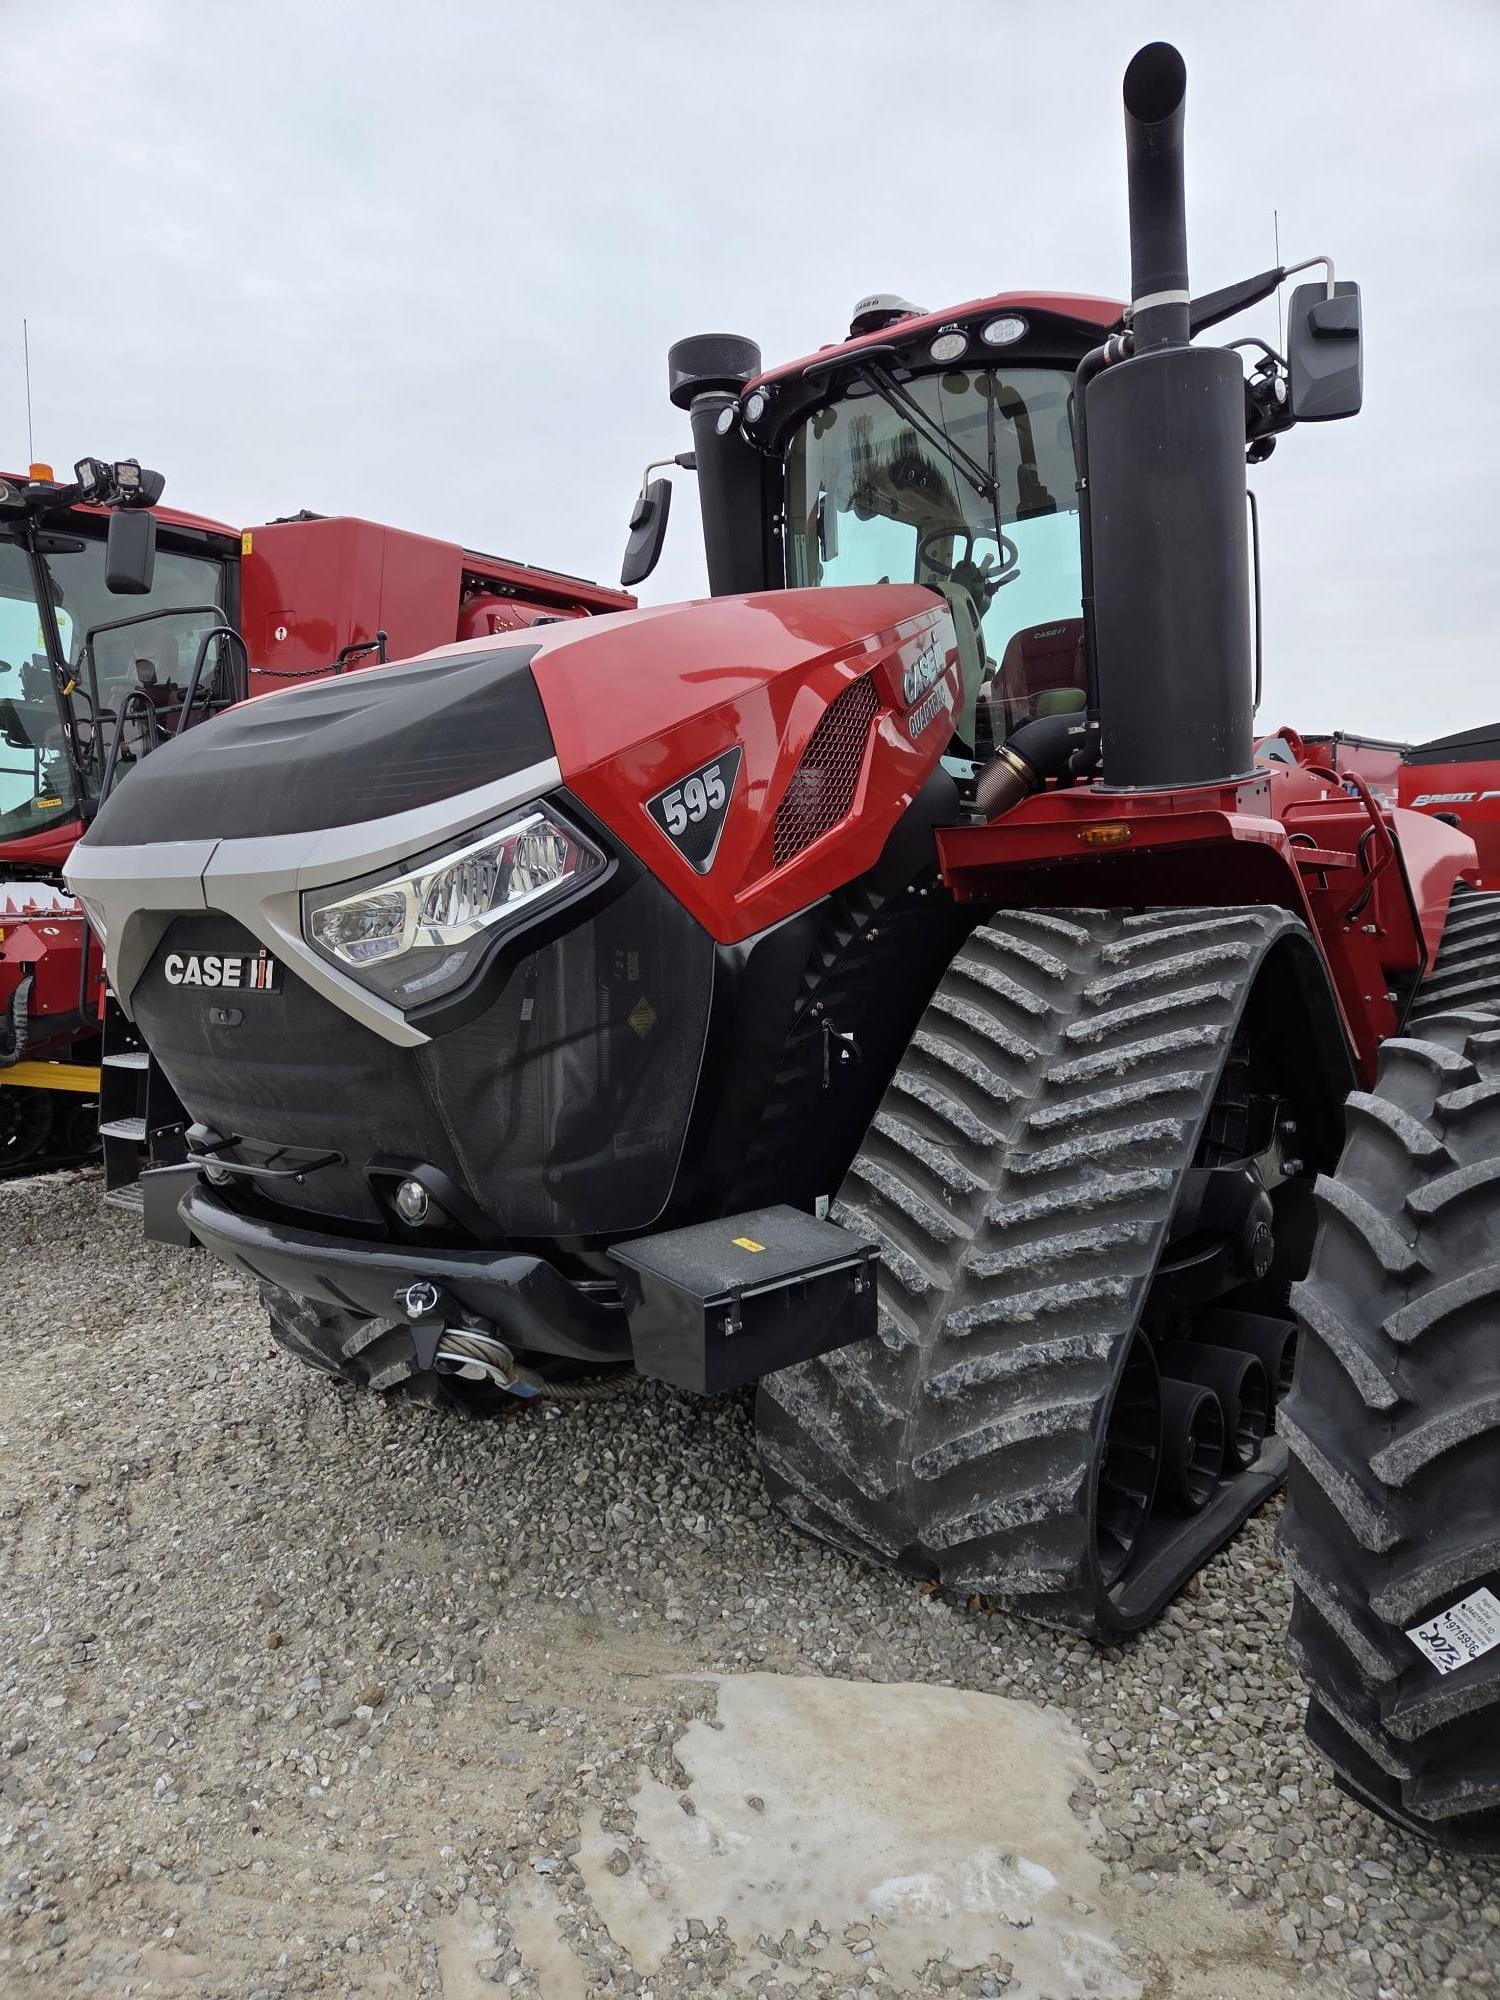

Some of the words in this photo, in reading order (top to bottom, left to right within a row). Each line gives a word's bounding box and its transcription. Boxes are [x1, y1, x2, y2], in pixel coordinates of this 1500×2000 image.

[1033, 629, 1057, 639] CASE
[904, 645, 938, 705] CASE
[908, 685, 947, 739] QUADTRAC
[662, 765, 726, 836] 595
[1410, 792, 1477, 807] BRENT
[164, 954, 242, 987] CASE
